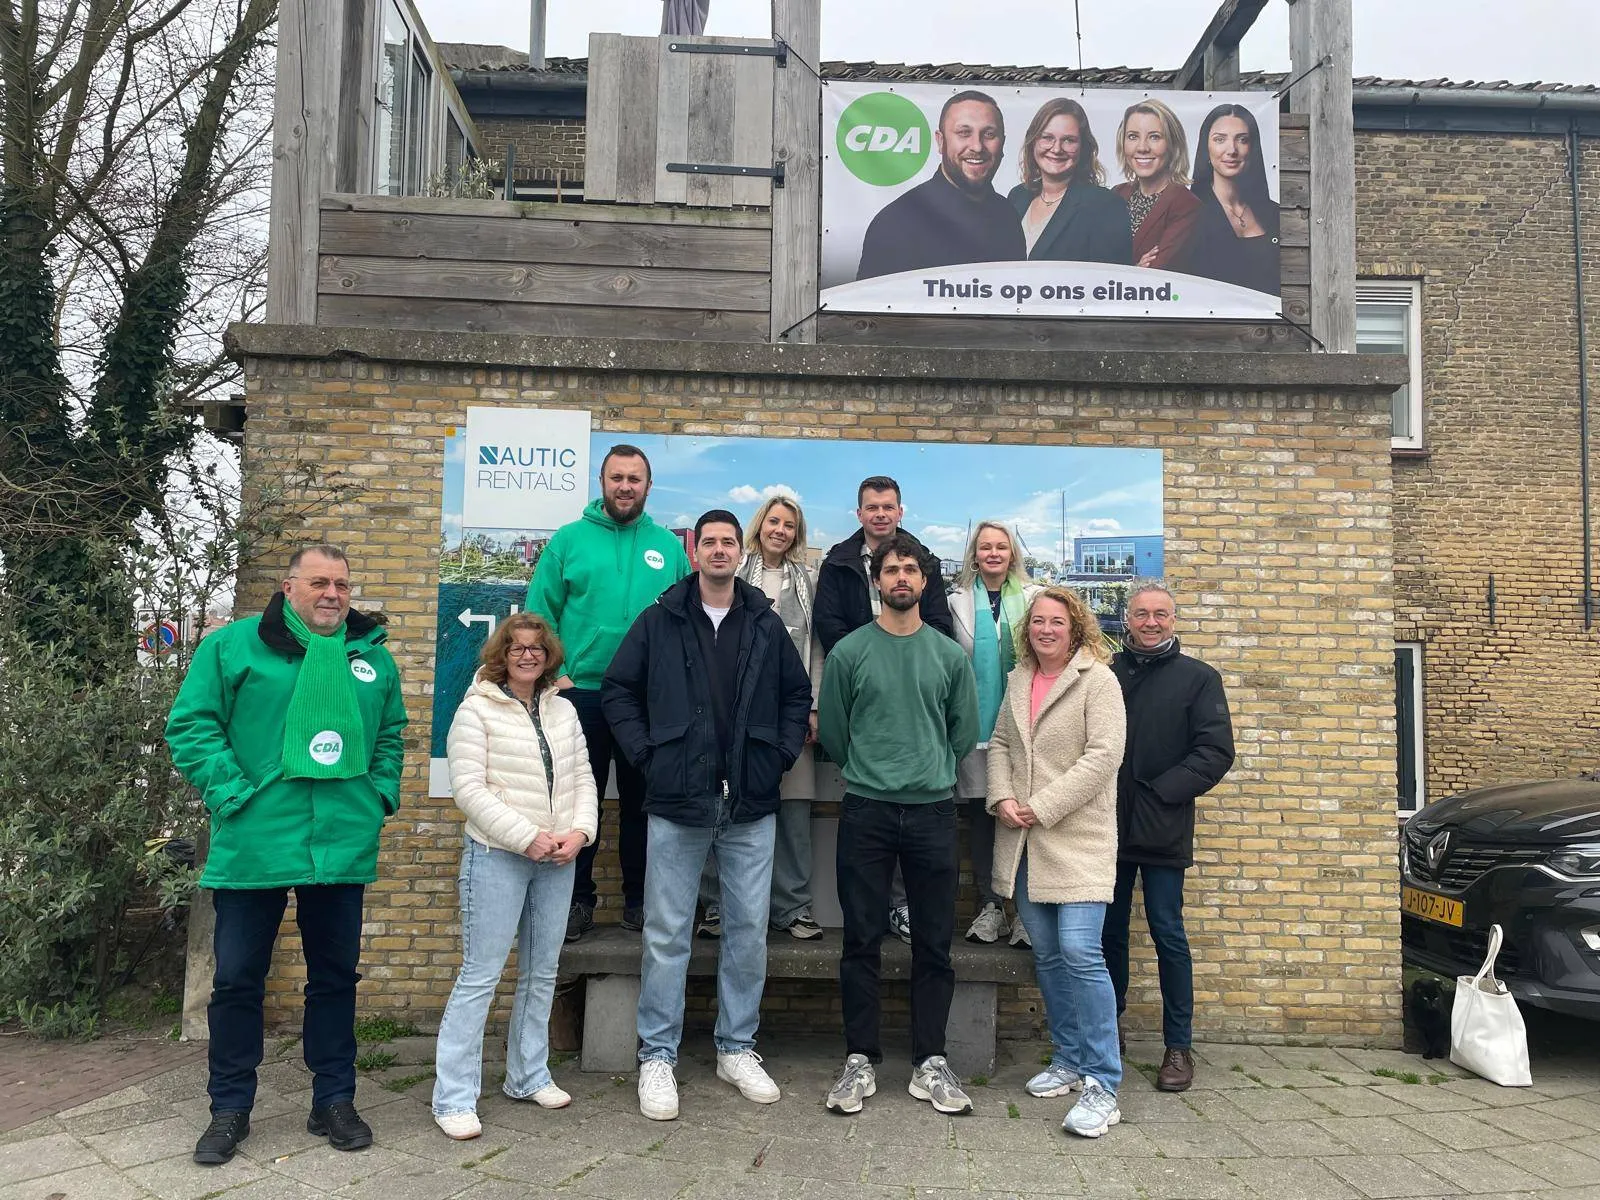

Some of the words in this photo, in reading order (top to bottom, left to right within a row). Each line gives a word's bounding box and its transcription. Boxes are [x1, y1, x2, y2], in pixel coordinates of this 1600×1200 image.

[844, 125, 922, 154] CDA
[923, 278, 993, 299] Thuis
[1000, 284, 1032, 304] op
[1039, 284, 1086, 301] ons
[1092, 279, 1180, 302] eiland.
[478, 446, 577, 468] NAUTIC
[477, 470, 576, 492] RENTALS
[646, 555, 663, 564] CDA
[353, 666, 373, 676] CDA
[312, 742, 340, 754] CDA
[1407, 891, 1455, 920] J-107-JV
